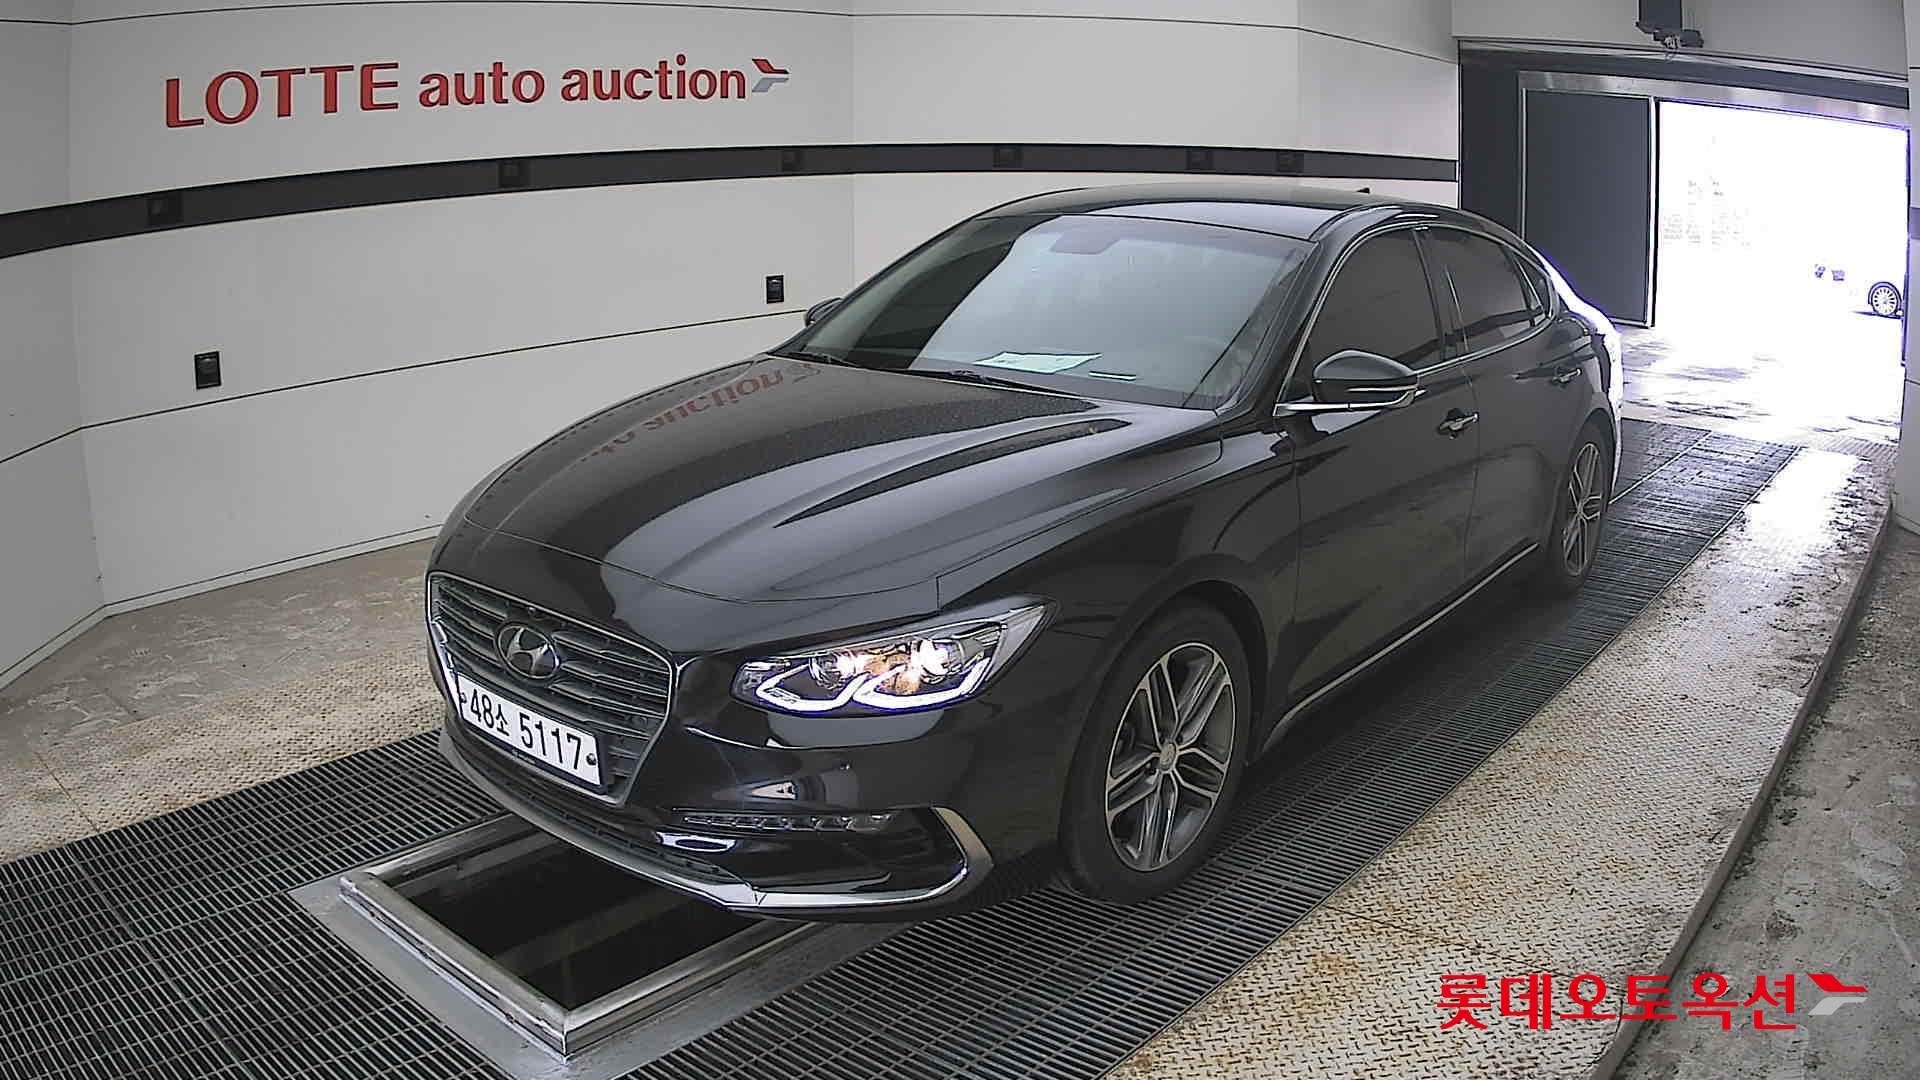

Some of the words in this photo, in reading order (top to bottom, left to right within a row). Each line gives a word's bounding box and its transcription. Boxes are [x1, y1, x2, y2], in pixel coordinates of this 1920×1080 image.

[165, 61, 400, 128] LOTTE
[418, 61, 546, 108] auto
[560, 53, 748, 101] auction
[470, 688, 511, 737] 48소
[519, 711, 582, 770] 5117
